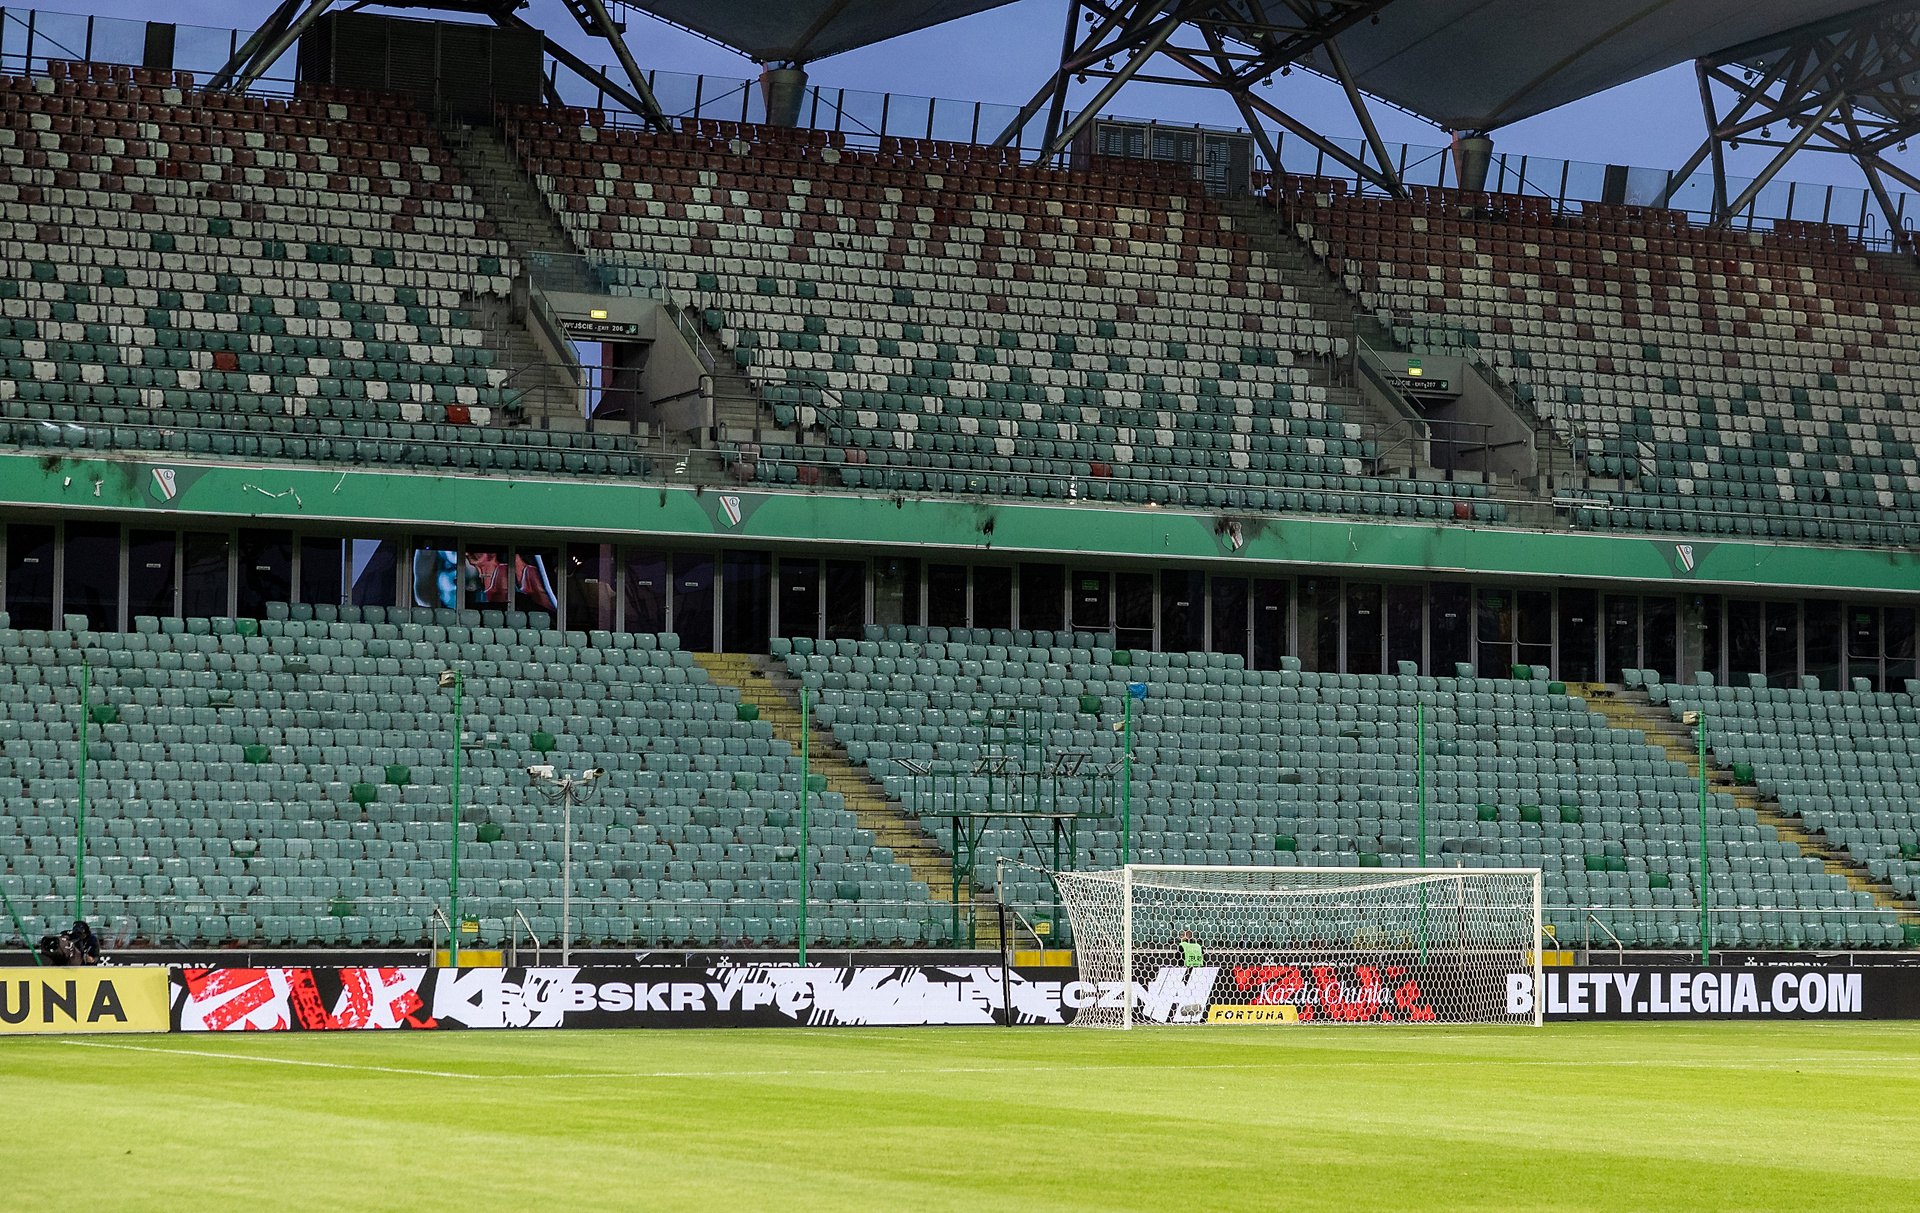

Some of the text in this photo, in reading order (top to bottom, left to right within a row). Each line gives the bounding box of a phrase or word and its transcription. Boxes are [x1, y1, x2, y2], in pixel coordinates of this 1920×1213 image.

[0, 980, 128, 1024] UNA
[1257, 981, 1320, 1005] Każda
[1215, 1010, 1284, 1020] FORTUNA
